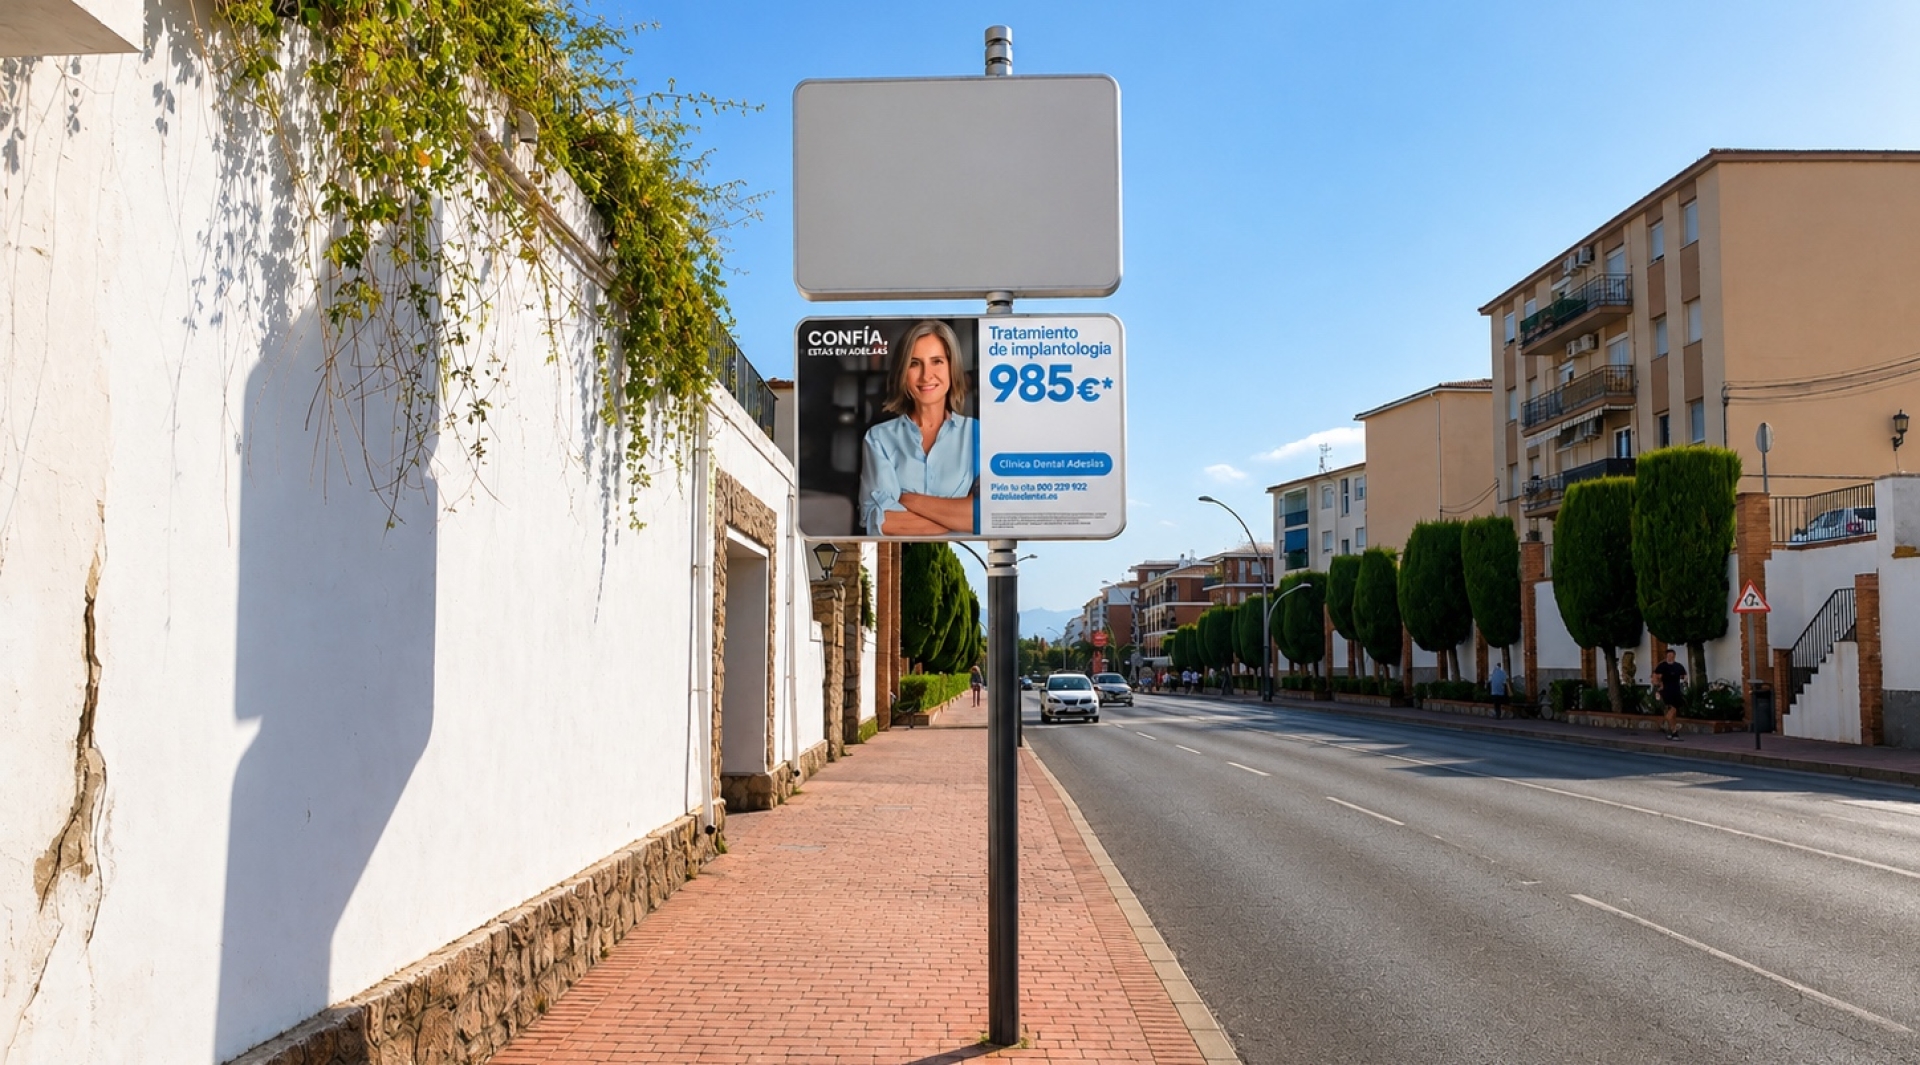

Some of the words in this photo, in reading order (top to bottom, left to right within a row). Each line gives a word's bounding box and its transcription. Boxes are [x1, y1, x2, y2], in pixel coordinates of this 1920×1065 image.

[989, 326, 1078, 340] Tratamiento
[989, 342, 1008, 356] de
[1033, 459, 1065, 469] Dental
